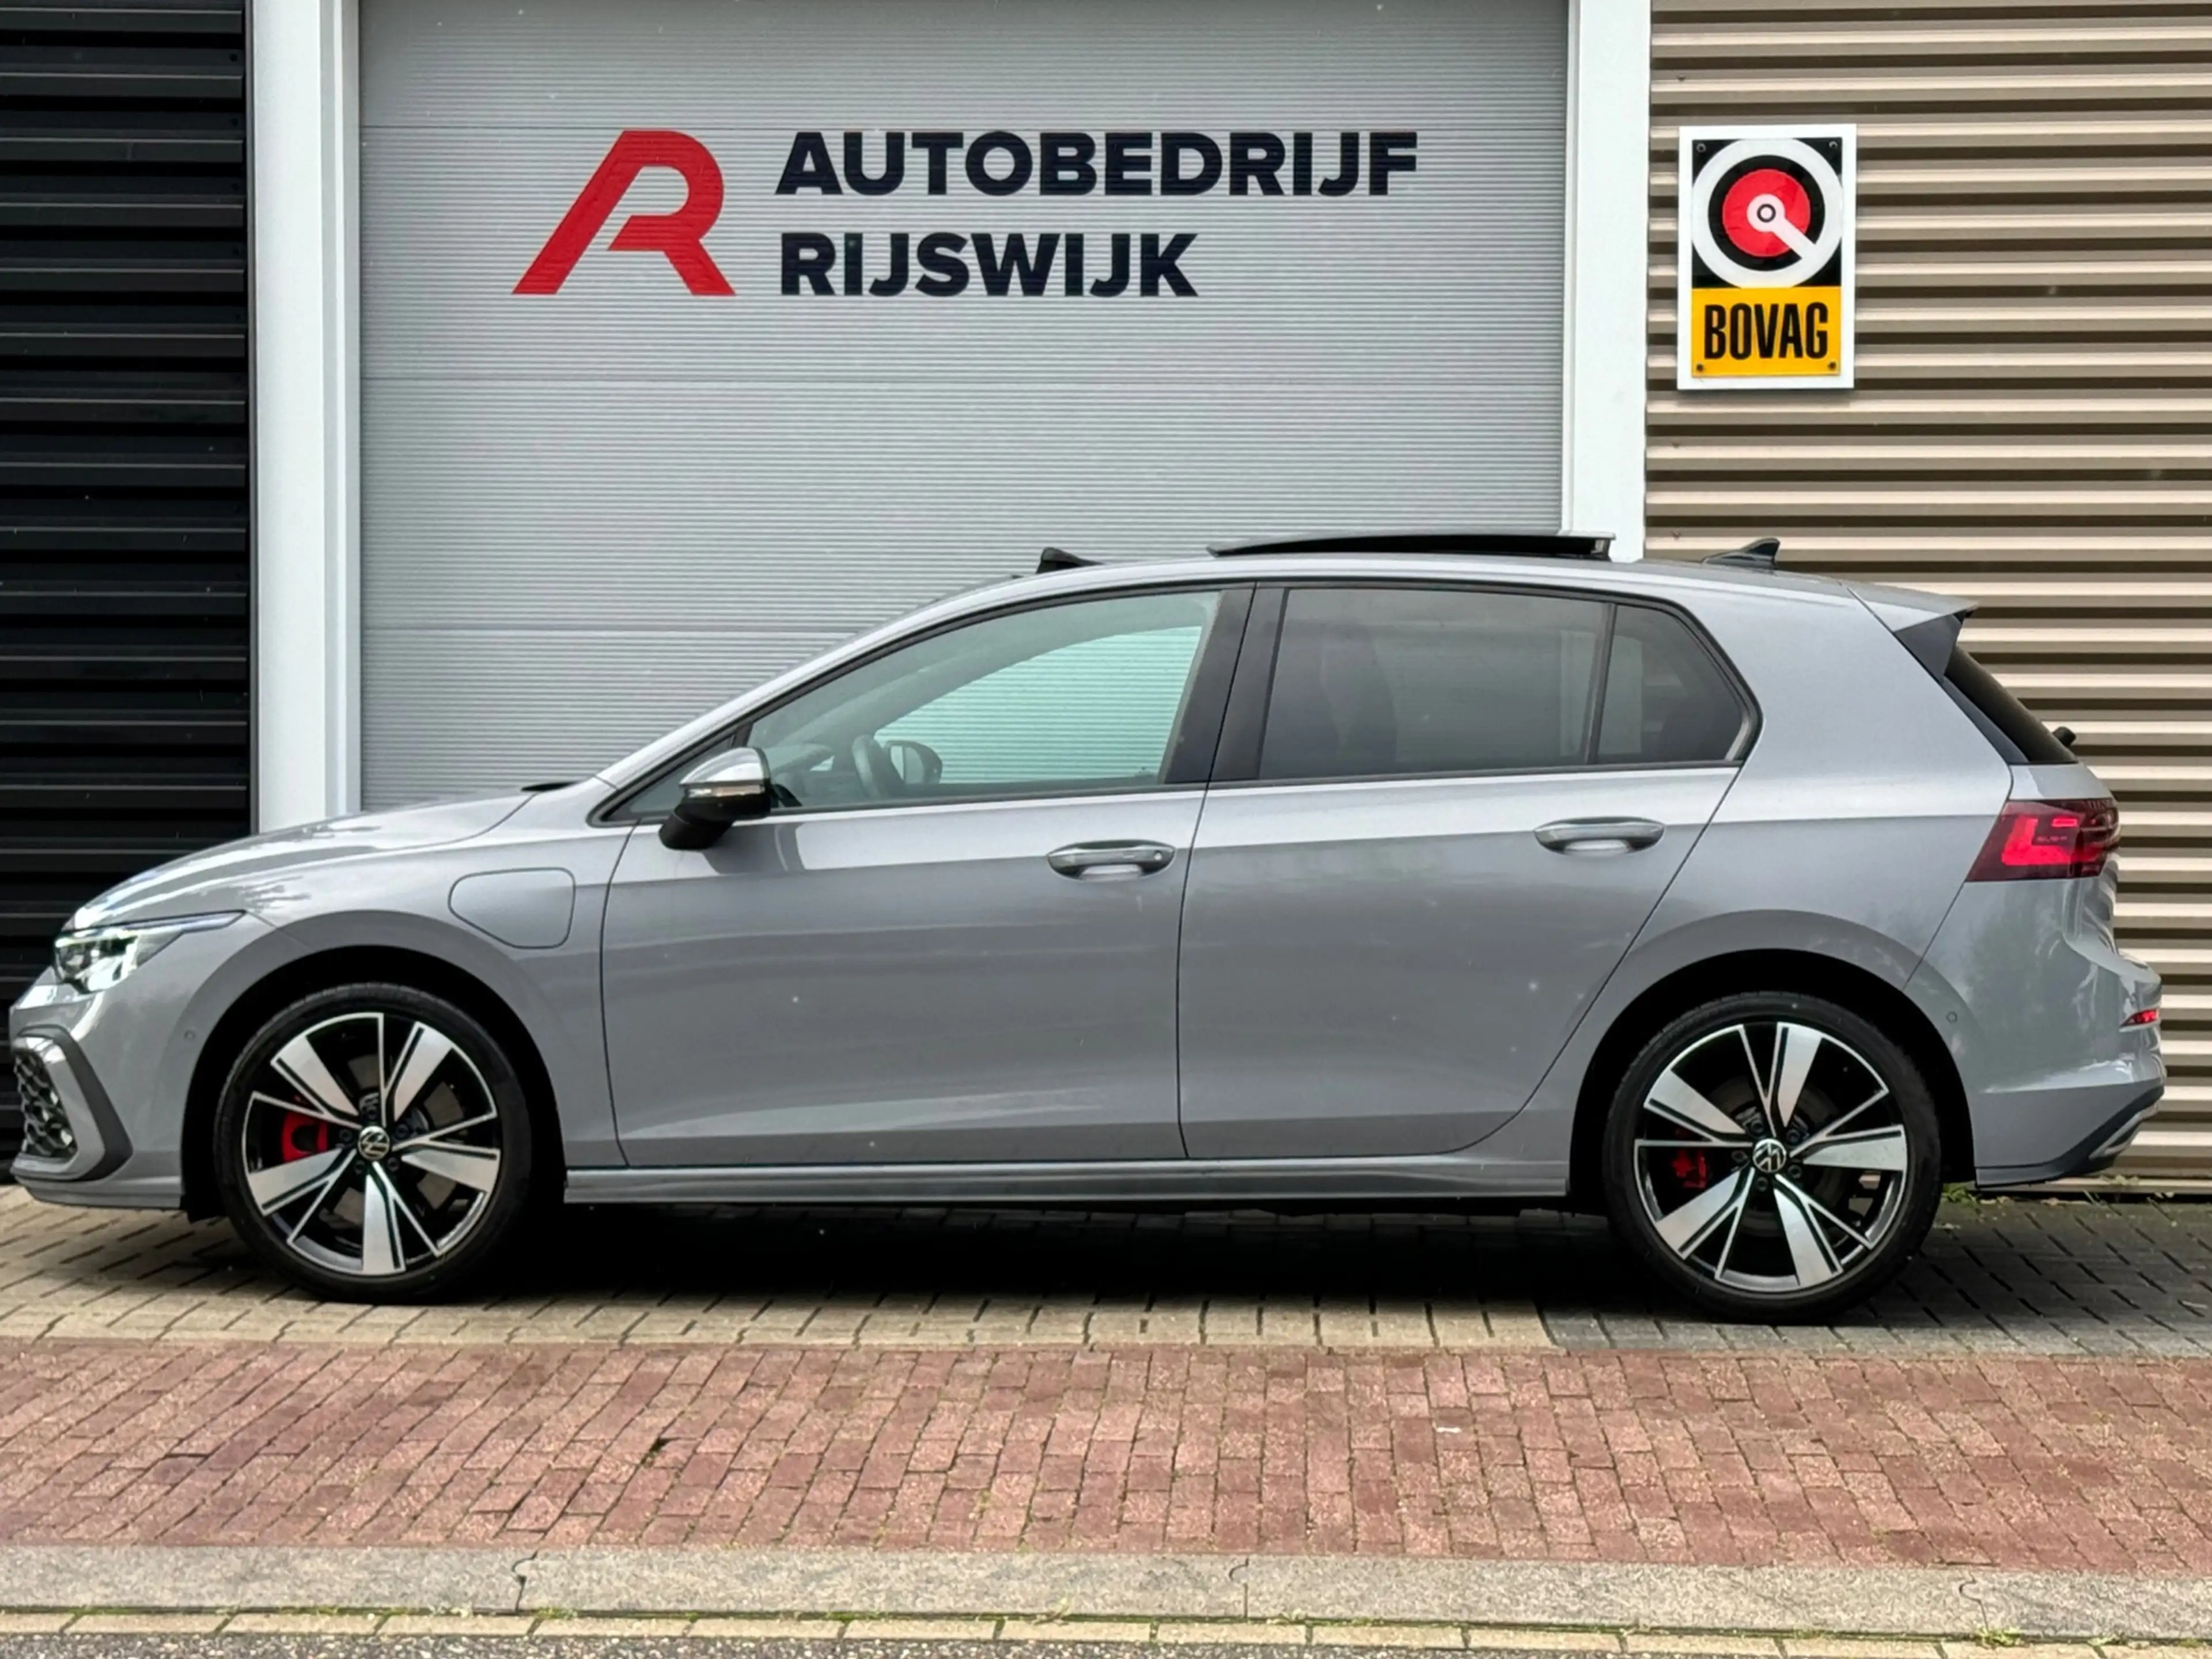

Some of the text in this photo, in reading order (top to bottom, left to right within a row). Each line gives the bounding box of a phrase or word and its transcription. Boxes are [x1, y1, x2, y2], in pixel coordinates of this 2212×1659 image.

[775, 130, 1418, 196] AUTOBEDRIJF
[781, 232, 1198, 297] RIJSWIJK
[1704, 302, 1829, 360] BOVAG
